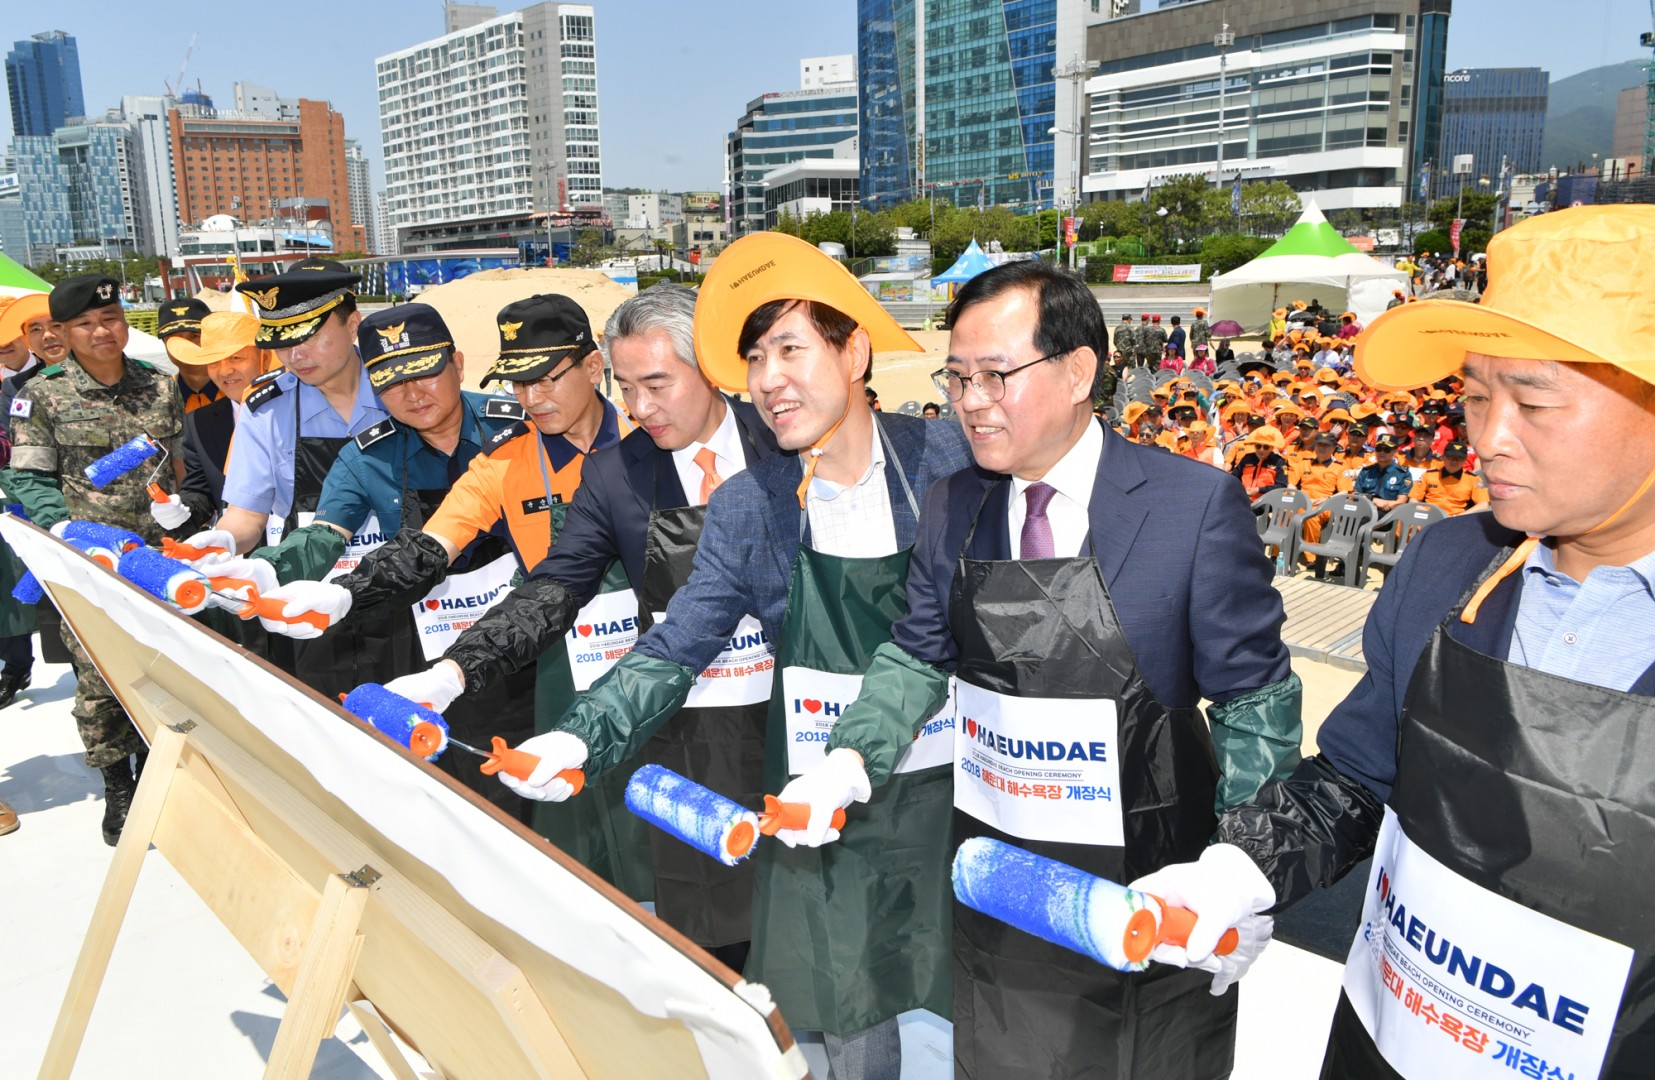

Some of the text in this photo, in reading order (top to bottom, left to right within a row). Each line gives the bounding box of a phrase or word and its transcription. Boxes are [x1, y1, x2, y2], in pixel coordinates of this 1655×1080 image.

[424, 623, 451, 635] 2018
[576, 652, 603, 664] 2018
[733, 658, 774, 678] 해수욕장
[795, 717, 955, 743] 2018 개장식
[977, 724, 1107, 762] HAEUNDAE
[961, 757, 981, 778] 2018
[1007, 780, 1063, 800] 해수욕장
[1066, 785, 1112, 802] 개장식
[1014, 769, 1043, 778] OPENING
[1044, 771, 1082, 779] CEREMONY
[1385, 886, 1590, 1037] HAEUNDAE
[1399, 956, 1422, 982] BEACH
[1422, 976, 1464, 1009] OPENING
[1466, 1004, 1531, 1040] CEREMONY
[1404, 986, 1490, 1055] 해수욕장
